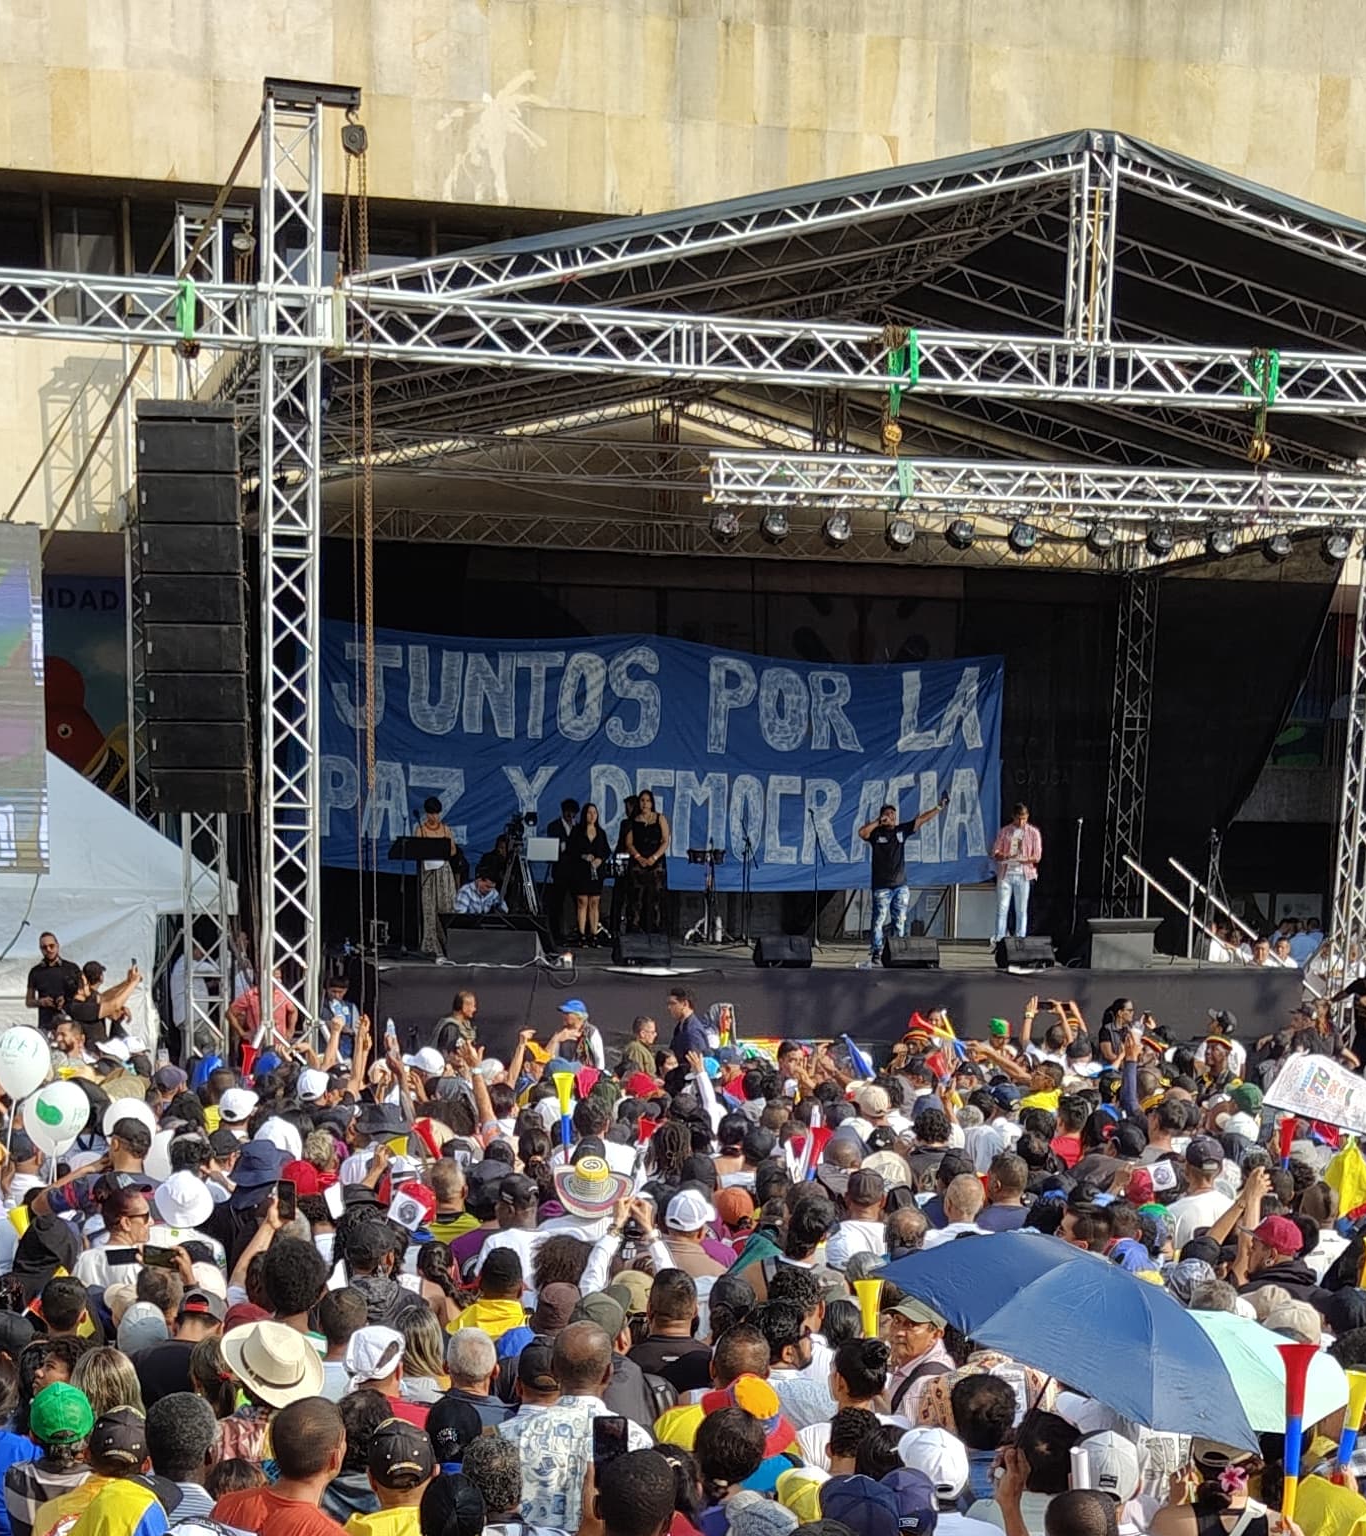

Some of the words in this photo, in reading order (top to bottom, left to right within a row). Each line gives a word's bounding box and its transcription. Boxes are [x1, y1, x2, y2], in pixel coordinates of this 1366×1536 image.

[333, 640, 661, 752] JUNTOS
[707, 655, 863, 755] POR
[898, 665, 983, 754] LA
[319, 754, 468, 846] PAZ
[501, 765, 559, 838] Y
[591, 764, 987, 865] DEMOCRACIA
